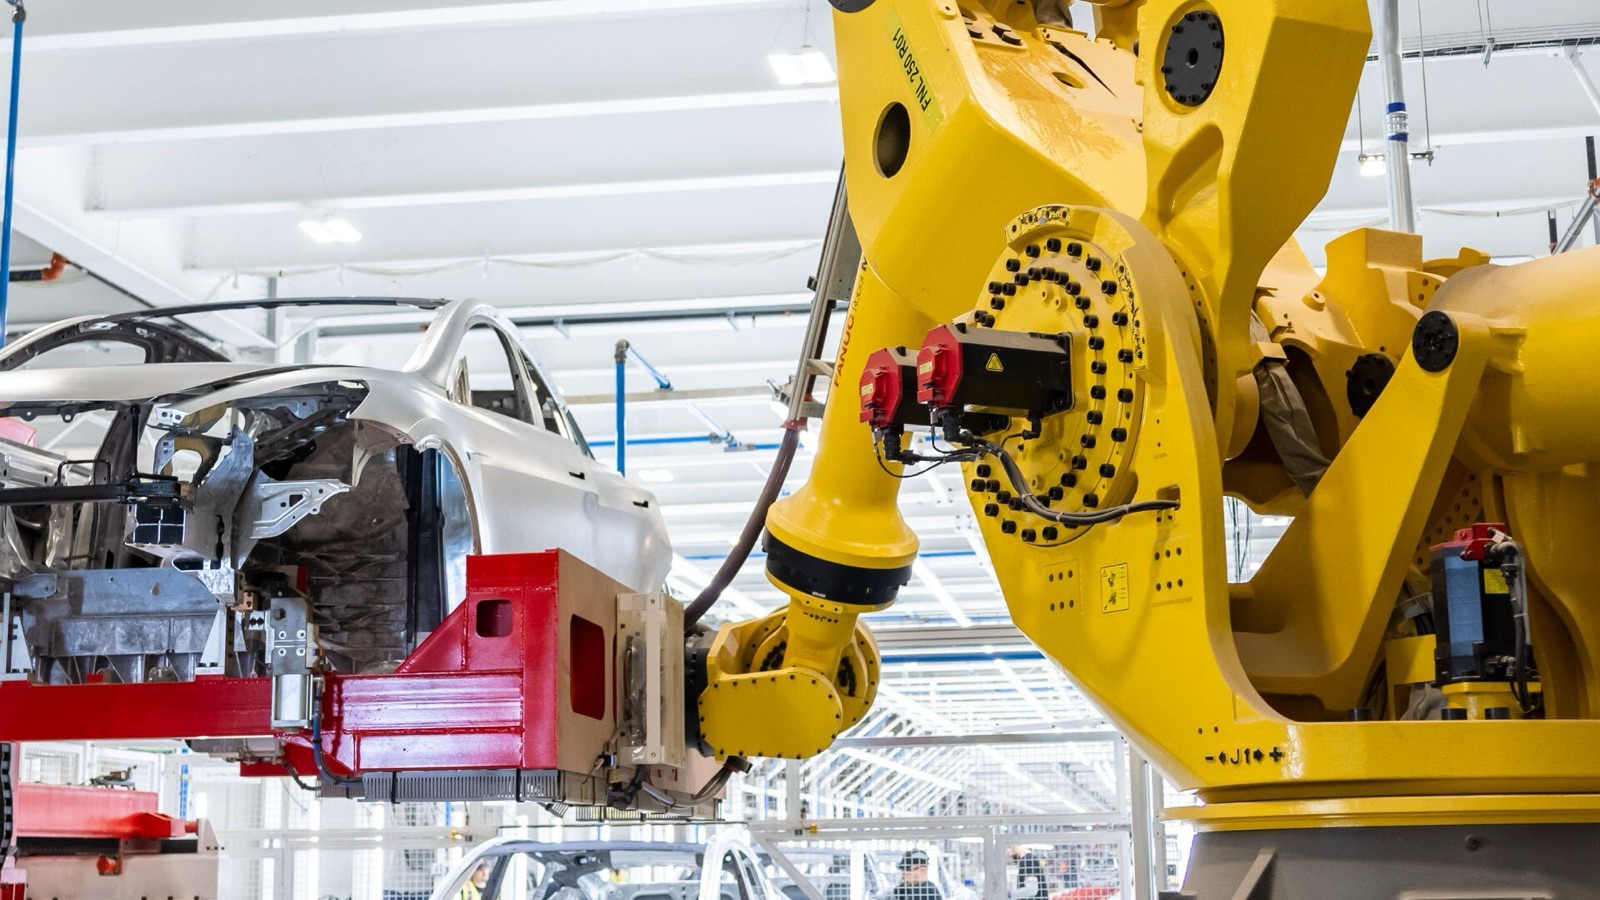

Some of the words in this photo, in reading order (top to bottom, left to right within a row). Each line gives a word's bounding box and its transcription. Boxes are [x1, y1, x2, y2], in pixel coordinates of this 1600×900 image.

[892, 27, 909, 59] R01
[903, 53, 920, 83] 250
[915, 76, 932, 112] FNL
[833, 314, 855, 387] FANUC
